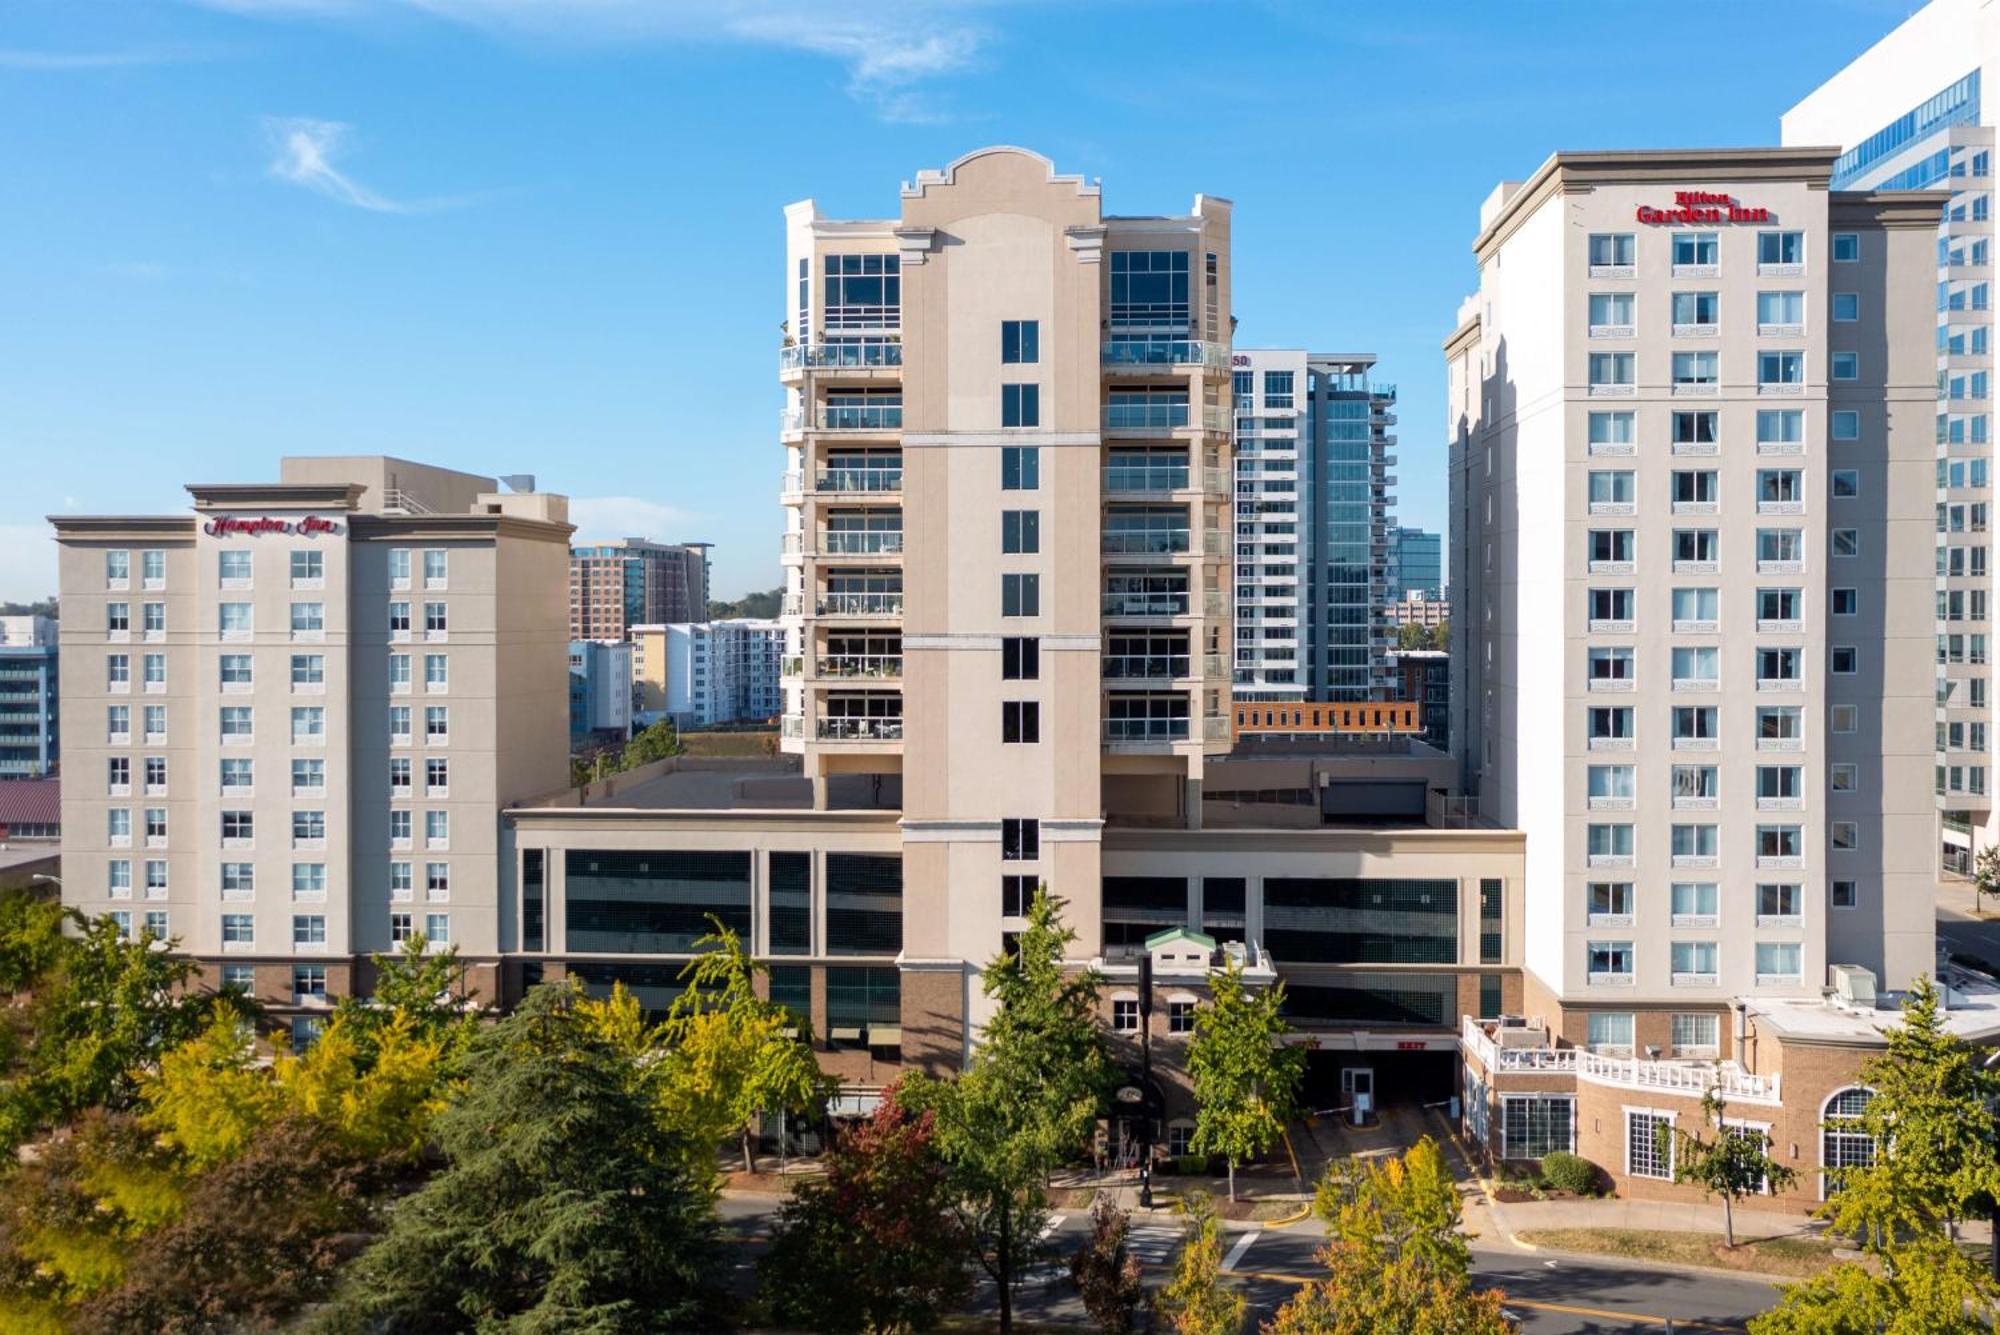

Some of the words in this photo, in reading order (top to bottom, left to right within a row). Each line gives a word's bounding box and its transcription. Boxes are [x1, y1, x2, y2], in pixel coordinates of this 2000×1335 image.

[1674, 191, 1730, 205] Hilton
[1637, 205, 1720, 224] Garden
[1727, 204, 1769, 223] Inn
[204, 516, 292, 536] Hampton
[297, 516, 338, 536] Inn
